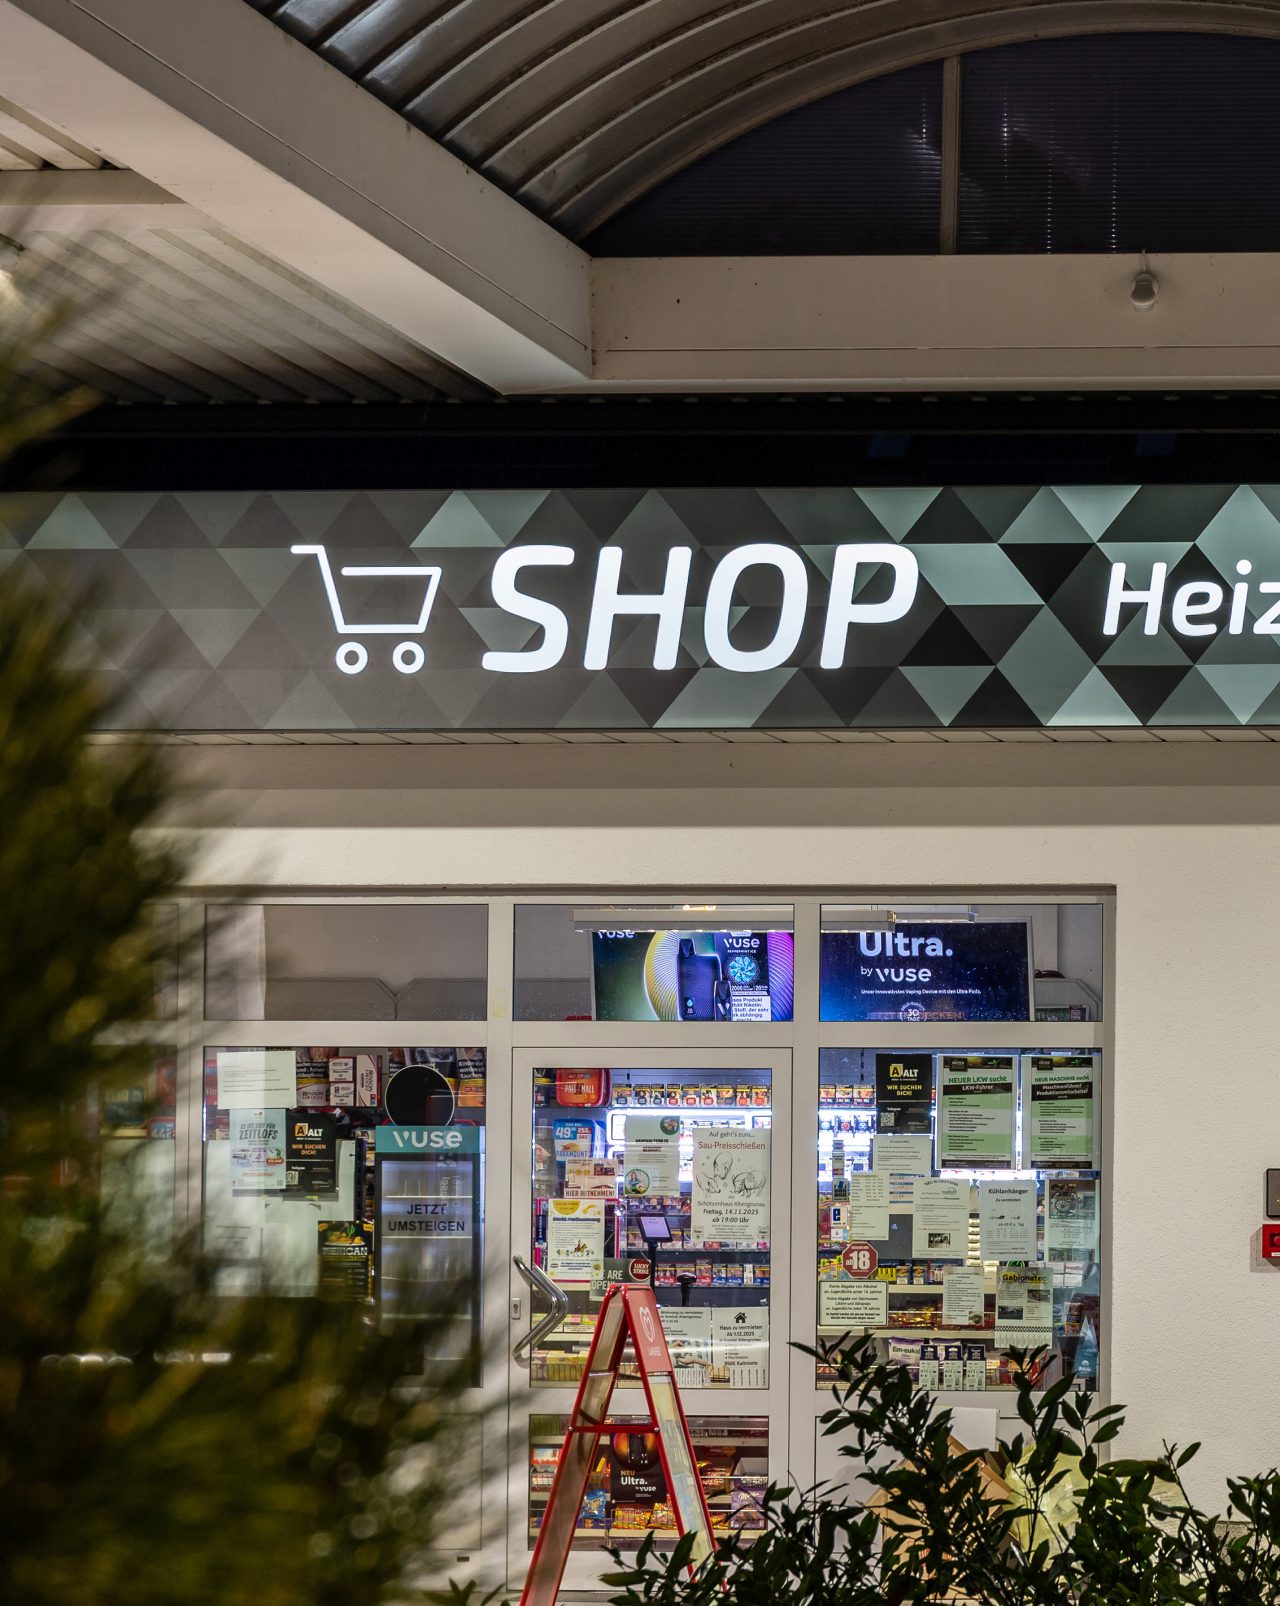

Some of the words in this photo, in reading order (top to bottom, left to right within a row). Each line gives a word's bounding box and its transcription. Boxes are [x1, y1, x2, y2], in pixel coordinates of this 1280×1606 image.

[482, 542, 920, 674] SHOP
[723, 937, 760, 948] vuse
[859, 931, 953, 957] Ultra.
[861, 966, 873, 977] by
[875, 967, 932, 982] vuse
[902, 1069, 919, 1077] ALT
[239, 1129, 278, 1140] ZEITLOFS
[307, 1128, 323, 1136] ALT
[556, 1127, 571, 1138] 49
[407, 1204, 447, 1214] JETZT
[388, 1220, 465, 1232] UMSTEIGEN
[849, 1250, 870, 1270] 18
[607, 1270, 623, 1280] ARE
[621, 1476, 648, 1485] Ultra.
